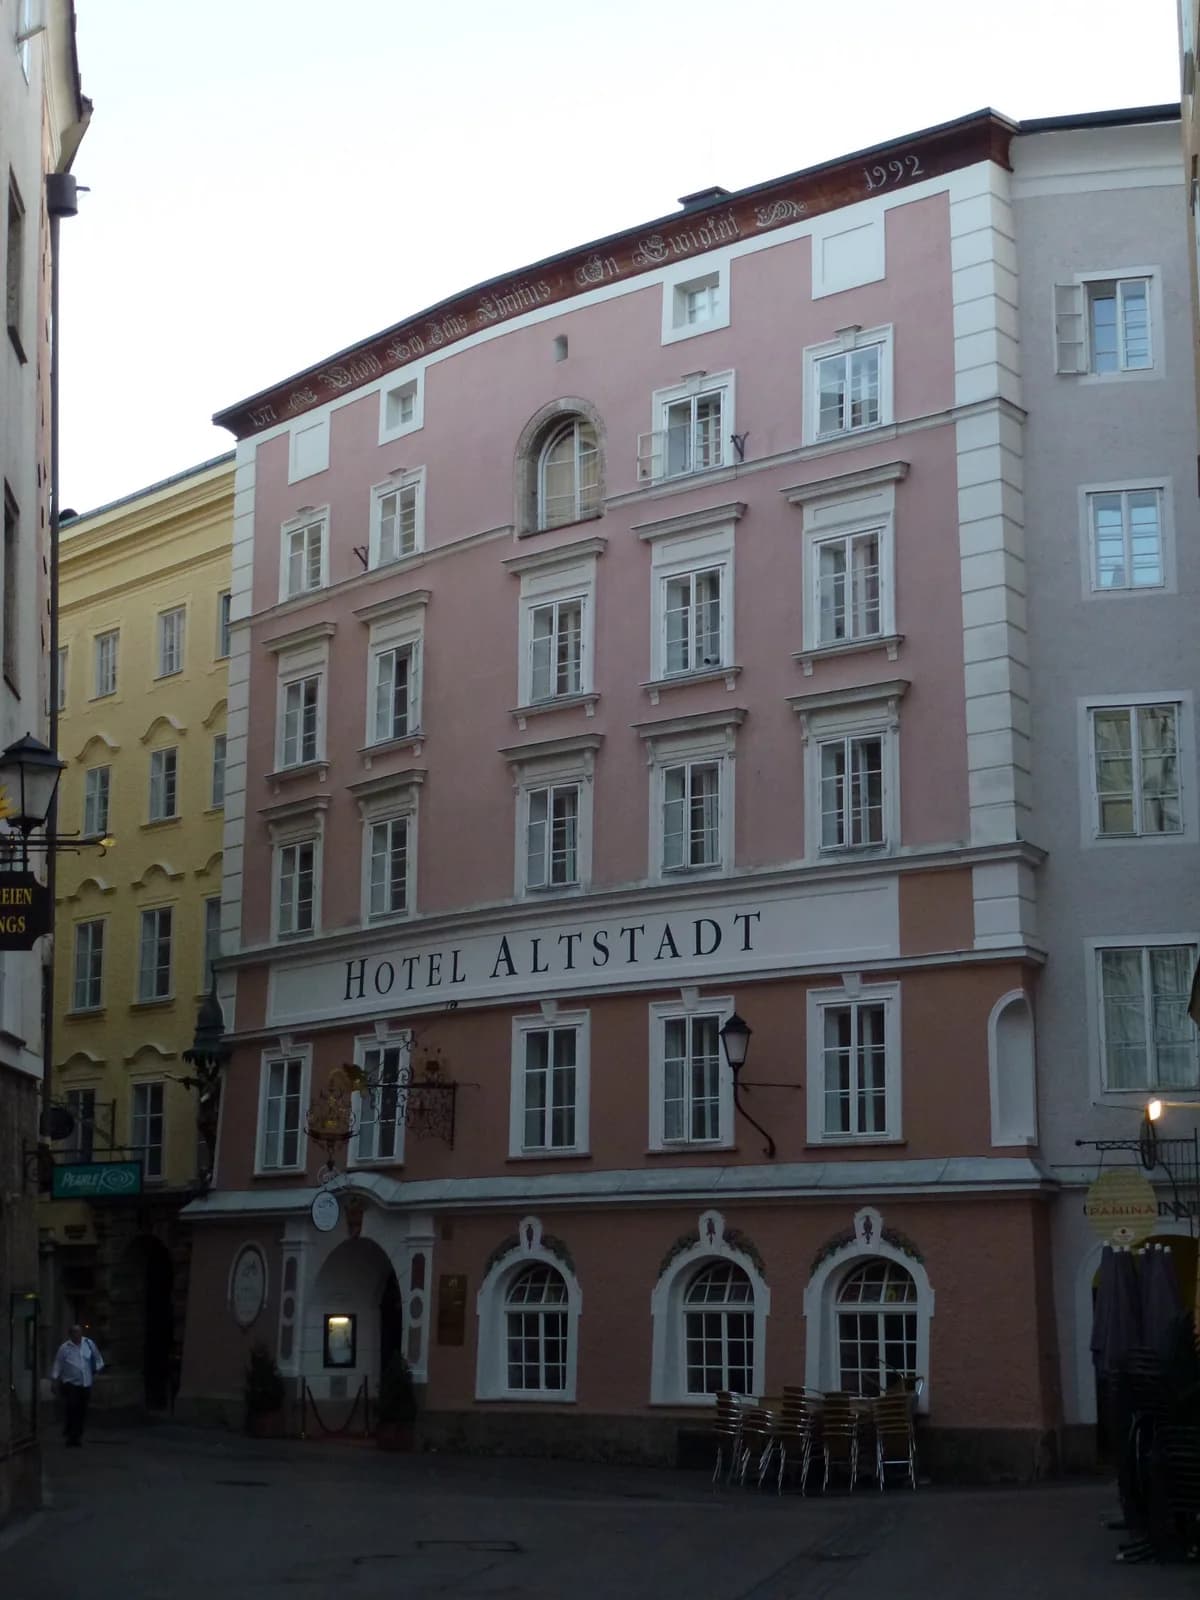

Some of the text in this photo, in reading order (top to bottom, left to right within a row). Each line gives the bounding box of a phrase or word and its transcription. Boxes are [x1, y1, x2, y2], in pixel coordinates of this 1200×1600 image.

[864, 155, 925, 190] 1992
[344, 911, 761, 1000] HOTEL ALTSTADT
